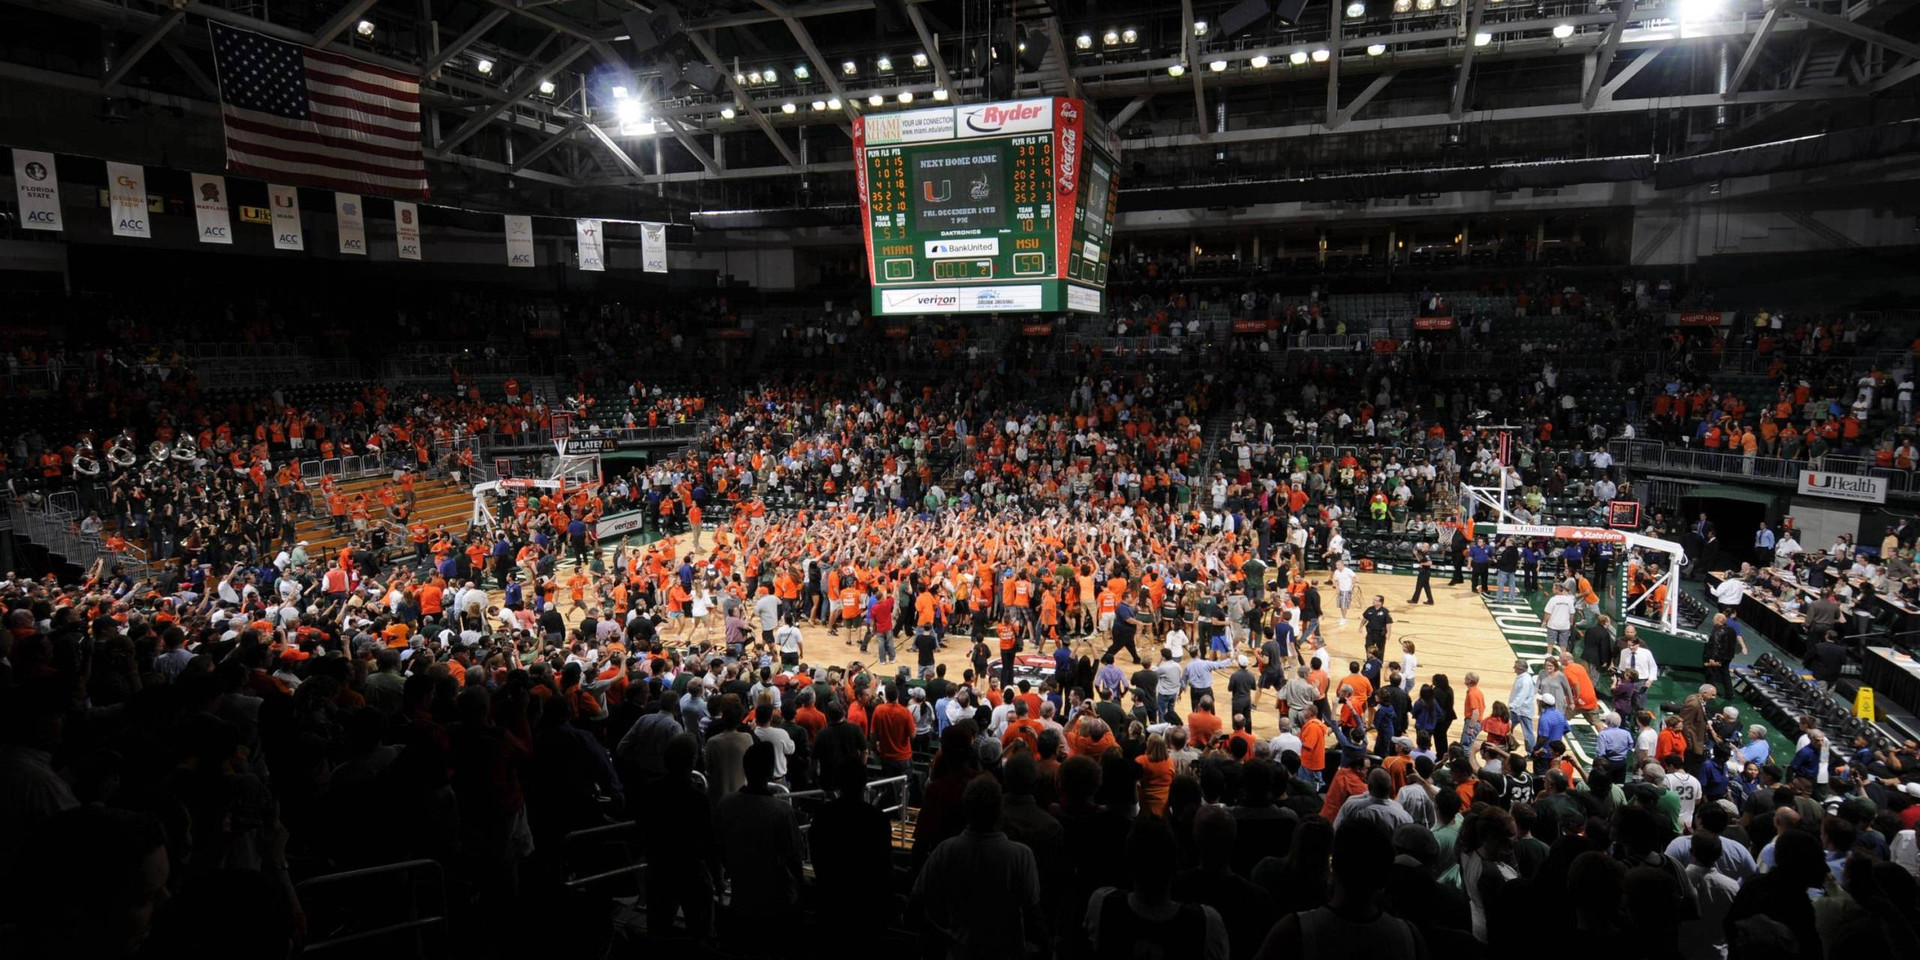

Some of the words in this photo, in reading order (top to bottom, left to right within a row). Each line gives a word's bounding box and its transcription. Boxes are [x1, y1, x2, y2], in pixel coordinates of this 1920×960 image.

[984, 104, 1042, 126] Ryder
[867, 119, 900, 132] MIAMI
[902, 119, 914, 127] YOUR
[924, 116, 954, 125] CONNECTION
[868, 130, 900, 141] ALUMNI
[868, 150, 880, 158] PLYR
[1020, 147, 1025, 156] 3
[1028, 146, 1034, 155] 0
[1044, 145, 1050, 154] 0
[1061, 127, 1076, 176] Coca-Cola
[875, 159, 880, 168] 0
[894, 156, 903, 166] 15
[920, 160, 943, 169] NEXT
[945, 158, 970, 167] HOME
[972, 155, 997, 164] GAME
[1041, 157, 1050, 166] 12
[884, 169, 890, 179] 0
[895, 168, 904, 177] 15
[1014, 170, 1026, 180] 20
[1030, 170, 1035, 179] 2
[1045, 168, 1050, 177] 9
[117, 175, 138, 189] GT
[896, 179, 904, 188] 18
[1014, 182, 1026, 191] 22
[1030, 182, 1035, 191] 2
[873, 192, 882, 201] 35
[886, 191, 891, 200] 2
[924, 180, 952, 202] U
[1015, 194, 1027, 203] 25
[1030, 193, 1036, 202] 2
[1046, 192, 1051, 201] 3
[873, 203, 883, 212] 42
[887, 202, 892, 211] 2
[897, 201, 906, 211] 10
[28, 211, 54, 221] ACC
[119, 219, 143, 230] ACC
[1022, 219, 1033, 231] 10
[205, 227, 225, 236] ACC
[884, 228, 890, 239] 5
[900, 227, 905, 238] 3
[279, 234, 298, 242] ACC
[1016, 238, 1039, 249] MSU
[403, 246, 417, 254] ACC
[883, 245, 913, 255] MIAMI
[949, 243, 993, 252] BankUnited
[1022, 256, 1040, 271] 59
[981, 267, 986, 275] 2
[918, 295, 956, 306] verizon
[580, 440, 603, 449] LATE?
[614, 520, 638, 530] verizon
[1676, 786, 1694, 800] 23
